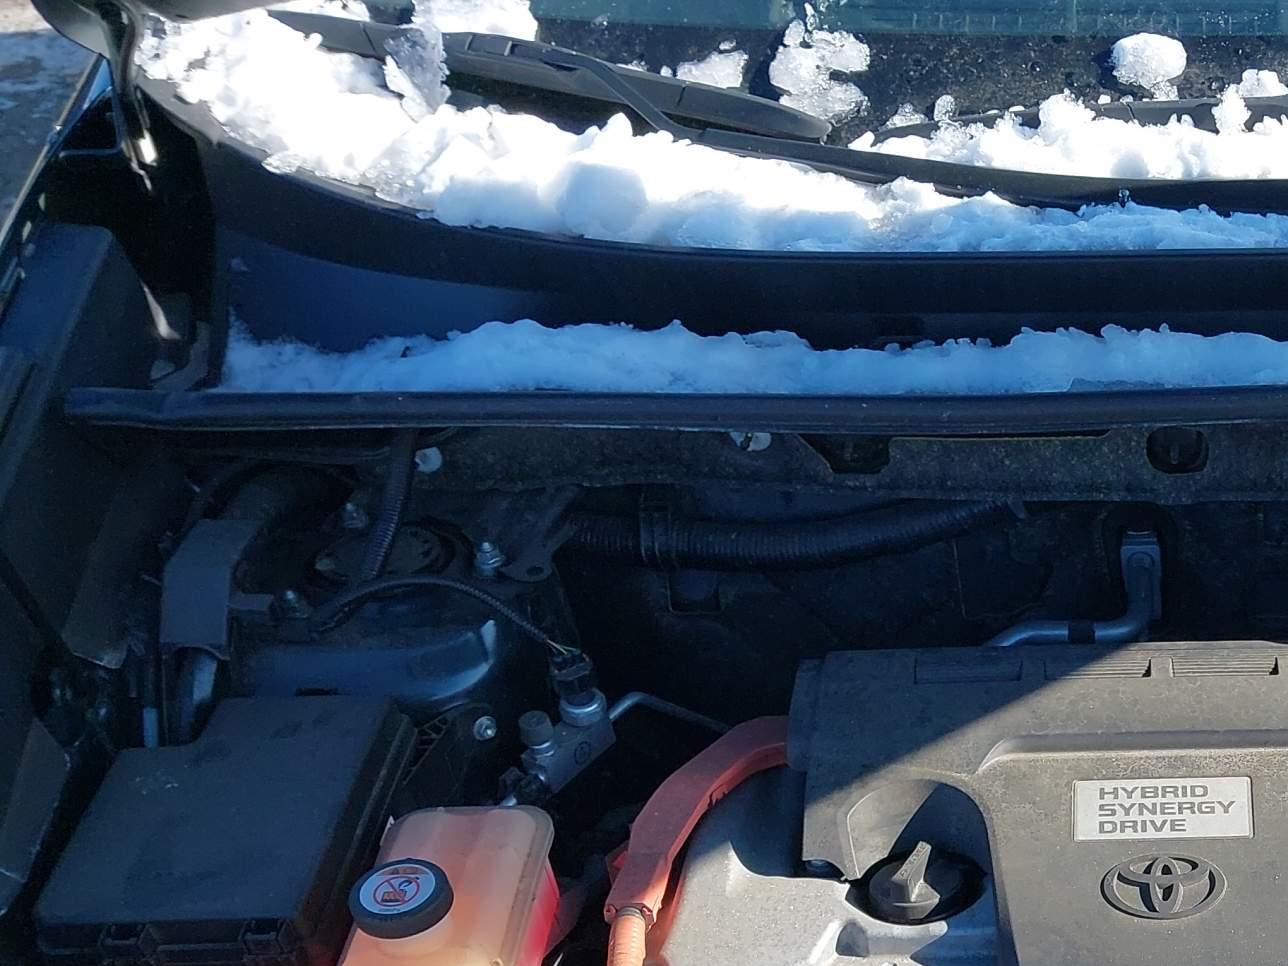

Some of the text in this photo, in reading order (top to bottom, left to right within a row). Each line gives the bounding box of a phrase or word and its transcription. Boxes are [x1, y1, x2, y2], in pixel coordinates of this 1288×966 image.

[1099, 785, 1209, 800] HYBRID
[1098, 801, 1236, 817] SYNERGY
[1098, 819, 1187, 834] DRIVE
